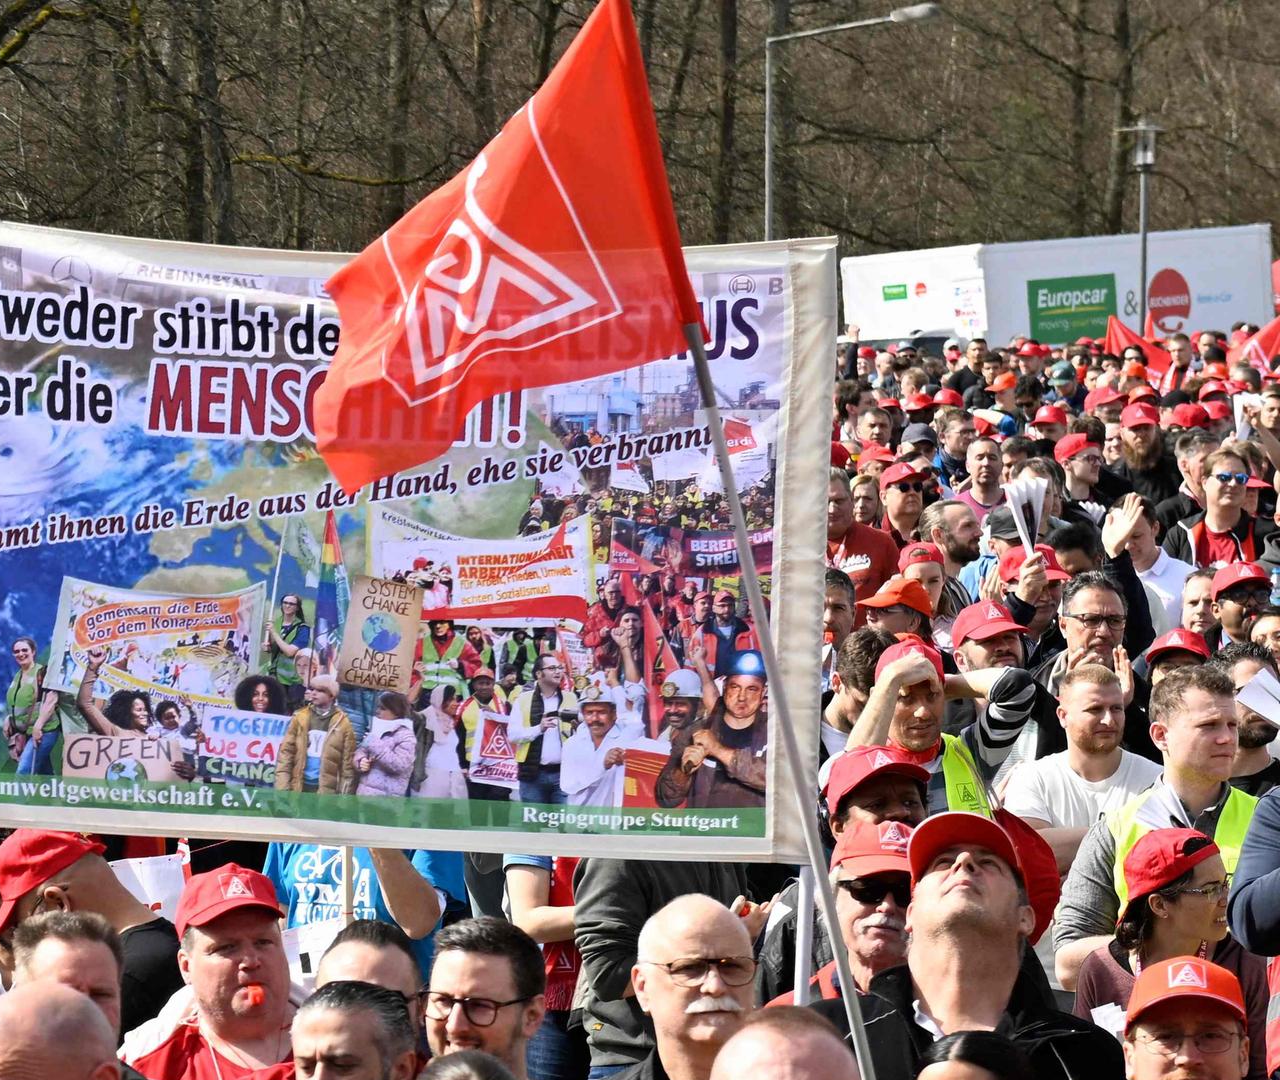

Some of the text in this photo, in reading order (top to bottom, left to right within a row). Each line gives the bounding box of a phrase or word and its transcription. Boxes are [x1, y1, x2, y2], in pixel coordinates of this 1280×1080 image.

[1037, 287, 1109, 312] Europcar
[159, 297, 273, 355] stirbt
[290, 302, 340, 359] de
[48, 358, 113, 425] die
[48, 503, 128, 539] ihnen
[134, 500, 175, 533] die
[181, 494, 253, 530] Erde
[258, 487, 306, 518] aus
[371, 463, 457, 505] Hand,
[466, 455, 518, 487] ehe
[524, 444, 564, 479] sie
[696, 551, 739, 568] STREI
[367, 578, 418, 601] SYSTEM
[86, 600, 220, 631] gemeinsam die Erde
[362, 595, 413, 616] CHANGE
[87, 626, 113, 643] vor
[118, 621, 147, 636] dem
[351, 658, 402, 679] CLIMATE
[363, 649, 394, 666] NOT
[344, 668, 400, 689] CHANGE
[66, 736, 173, 770] GREEN
[244, 740, 276, 761] CA
[221, 784, 262, 810] e.V.
[522, 807, 739, 832] Regiogruppe Stuttgart
